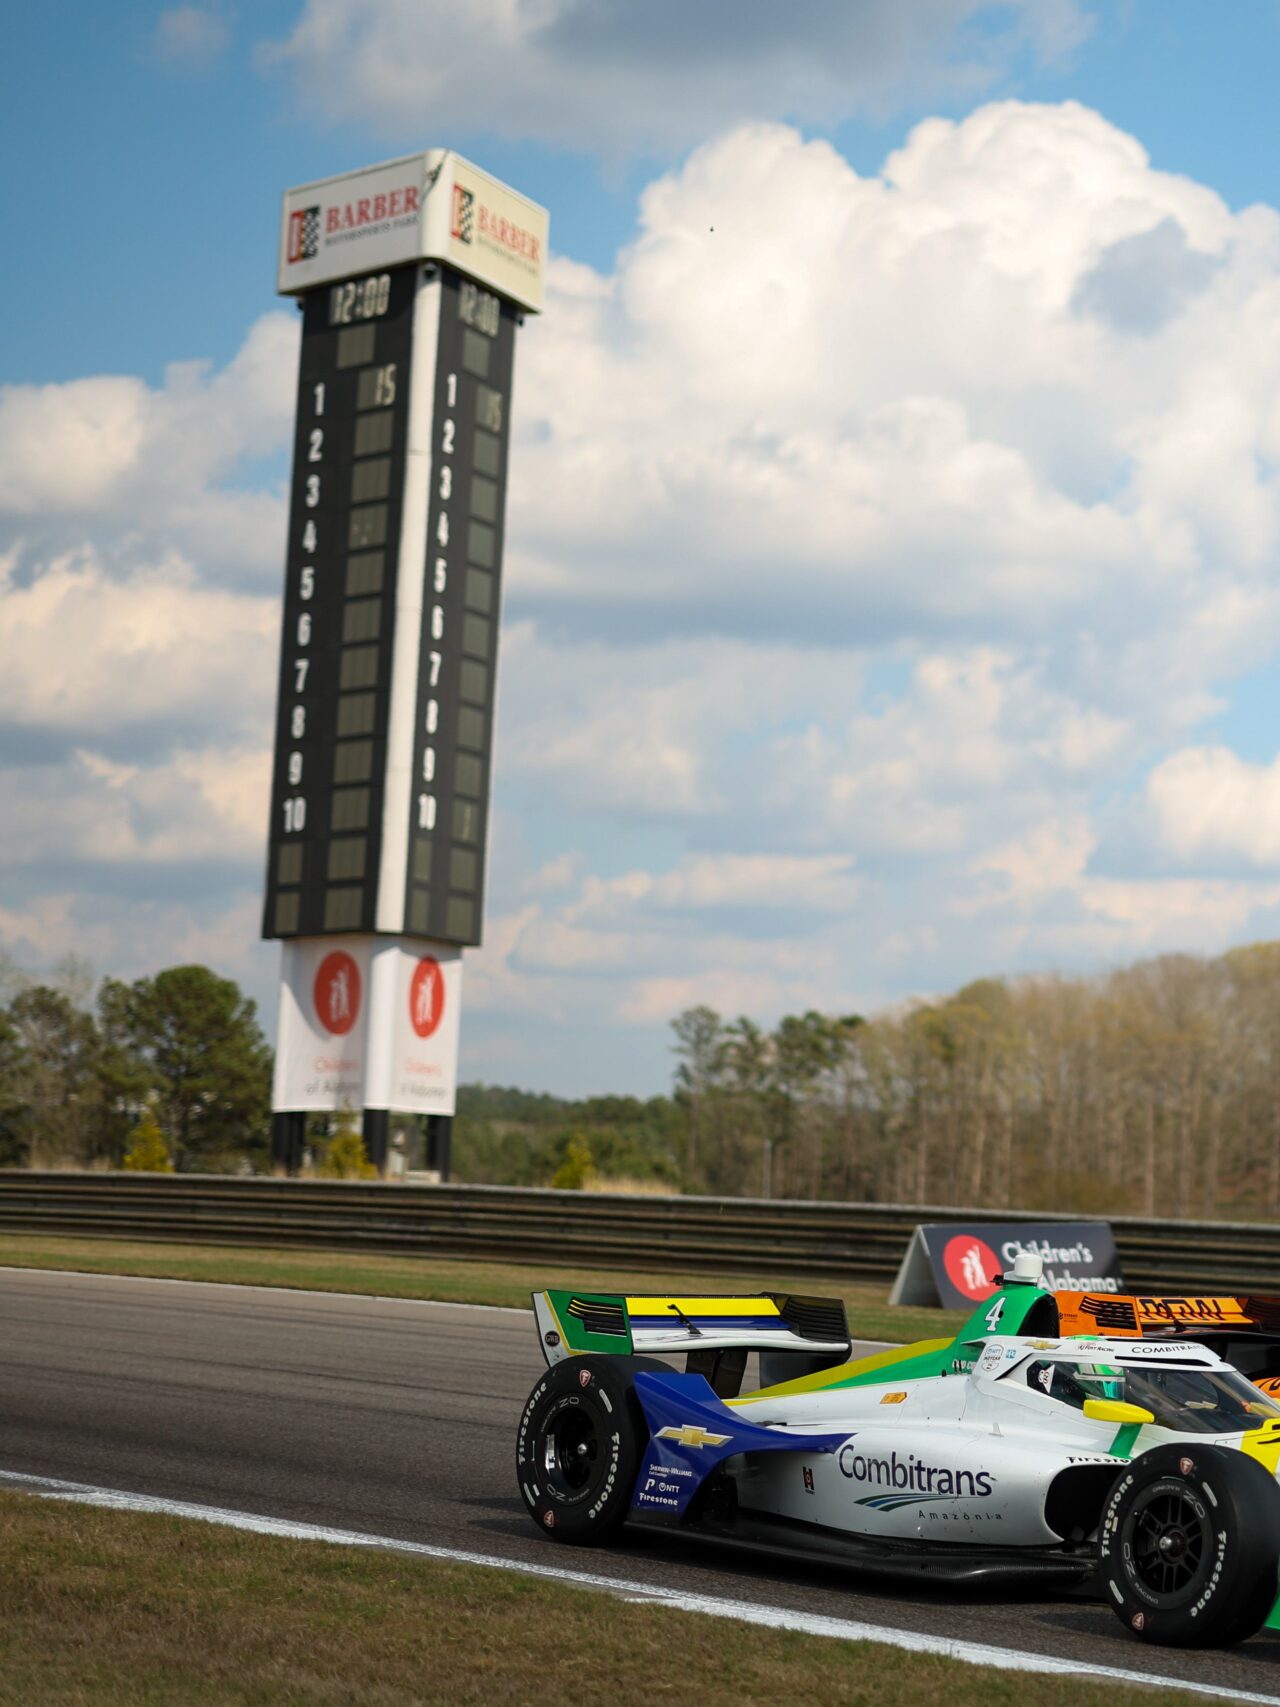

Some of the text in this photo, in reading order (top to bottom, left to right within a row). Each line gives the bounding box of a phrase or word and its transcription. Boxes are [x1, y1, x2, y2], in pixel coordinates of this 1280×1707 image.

[325, 186, 421, 235] BARBER
[477, 203, 541, 262] BARBER
[333, 274, 391, 325] 12:00
[314, 382, 325, 416] 1
[374, 363, 397, 406] 15
[447, 373, 457, 408] 1
[308, 428, 323, 462] 2
[442, 418, 455, 454] 2
[306, 474, 320, 508] 3
[440, 465, 452, 500] 3
[303, 520, 317, 553] 4
[437, 511, 449, 547] 4
[300, 566, 314, 600] 5
[434, 557, 447, 593] 5
[297, 612, 311, 646] 6
[431, 604, 444, 640] 6
[294, 658, 309, 693] 7
[429, 650, 441, 687] 7
[291, 705, 305, 739] 8
[426, 699, 438, 734] 8
[288, 751, 303, 785] 9
[423, 746, 435, 782] 9
[283, 796, 306, 833] 10
[418, 793, 436, 830] 10
[1001, 1240, 1094, 1264] Children's
[1039, 1270, 1118, 1293] Alabama
[984, 1296, 1006, 1333] 4
[518, 1382, 547, 1465] Firestone
[588, 1431, 620, 1519] Firestone
[666, 1484, 679, 1493] NTT
[838, 1444, 993, 1497] Combitrans
[639, 1492, 678, 1506] Firestone
[1101, 1474, 1134, 1558] Firestone
[1123, 1542, 1137, 1578] OZ
[1190, 1530, 1227, 1617] Firestone
